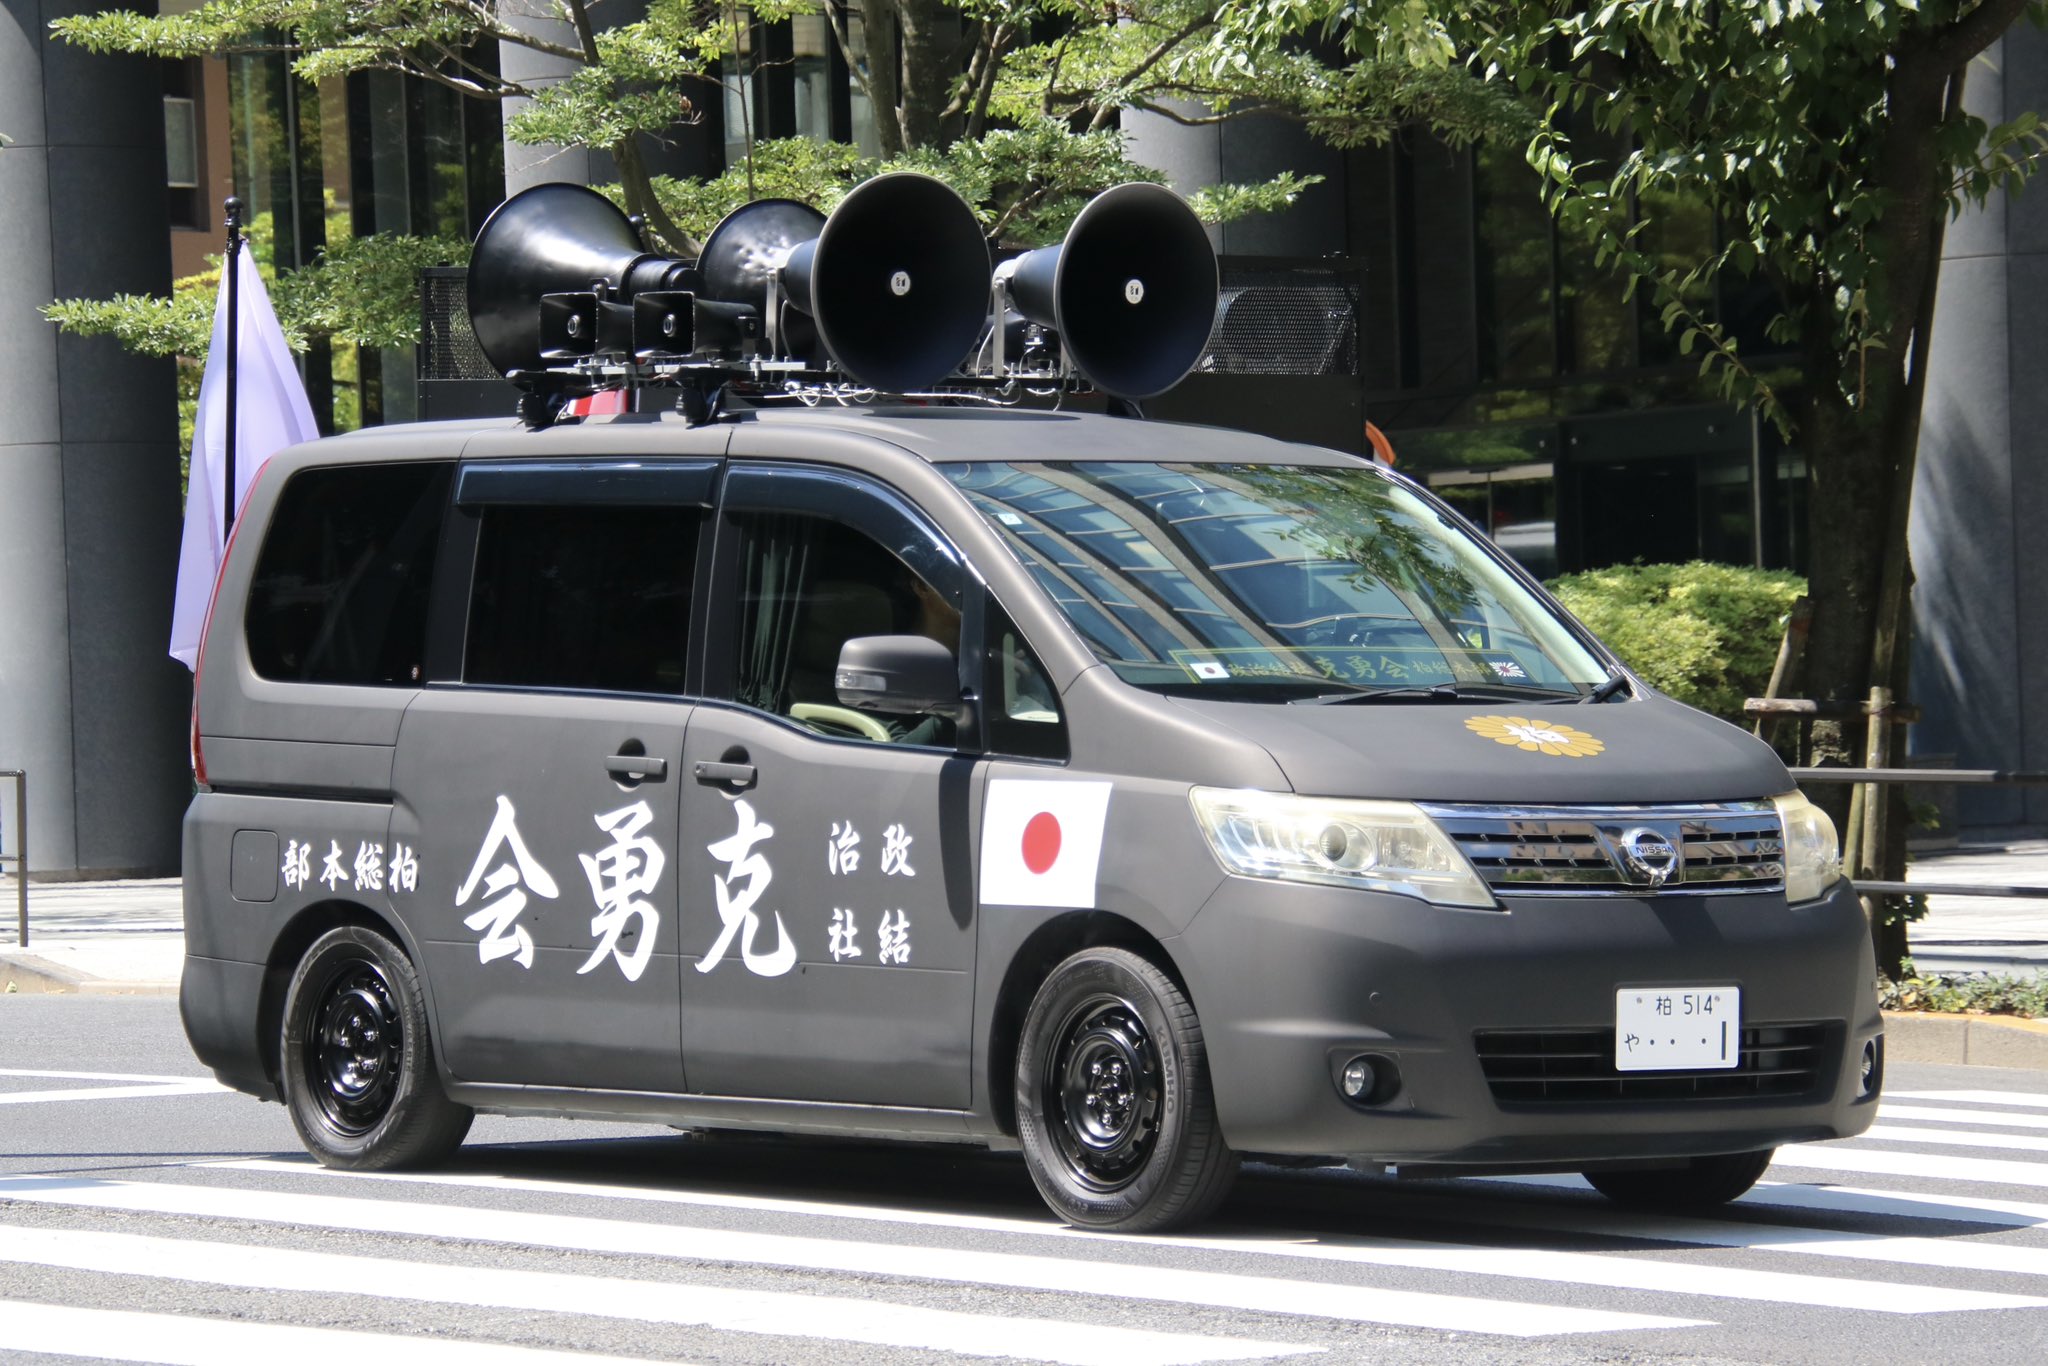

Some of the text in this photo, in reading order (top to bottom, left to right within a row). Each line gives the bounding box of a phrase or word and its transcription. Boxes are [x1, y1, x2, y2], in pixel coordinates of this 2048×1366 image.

[1636, 844, 1676, 855] NISSAN
[1655, 994, 1713, 1016] 柏 514
[1155, 1025, 1175, 1115] KUMHO
